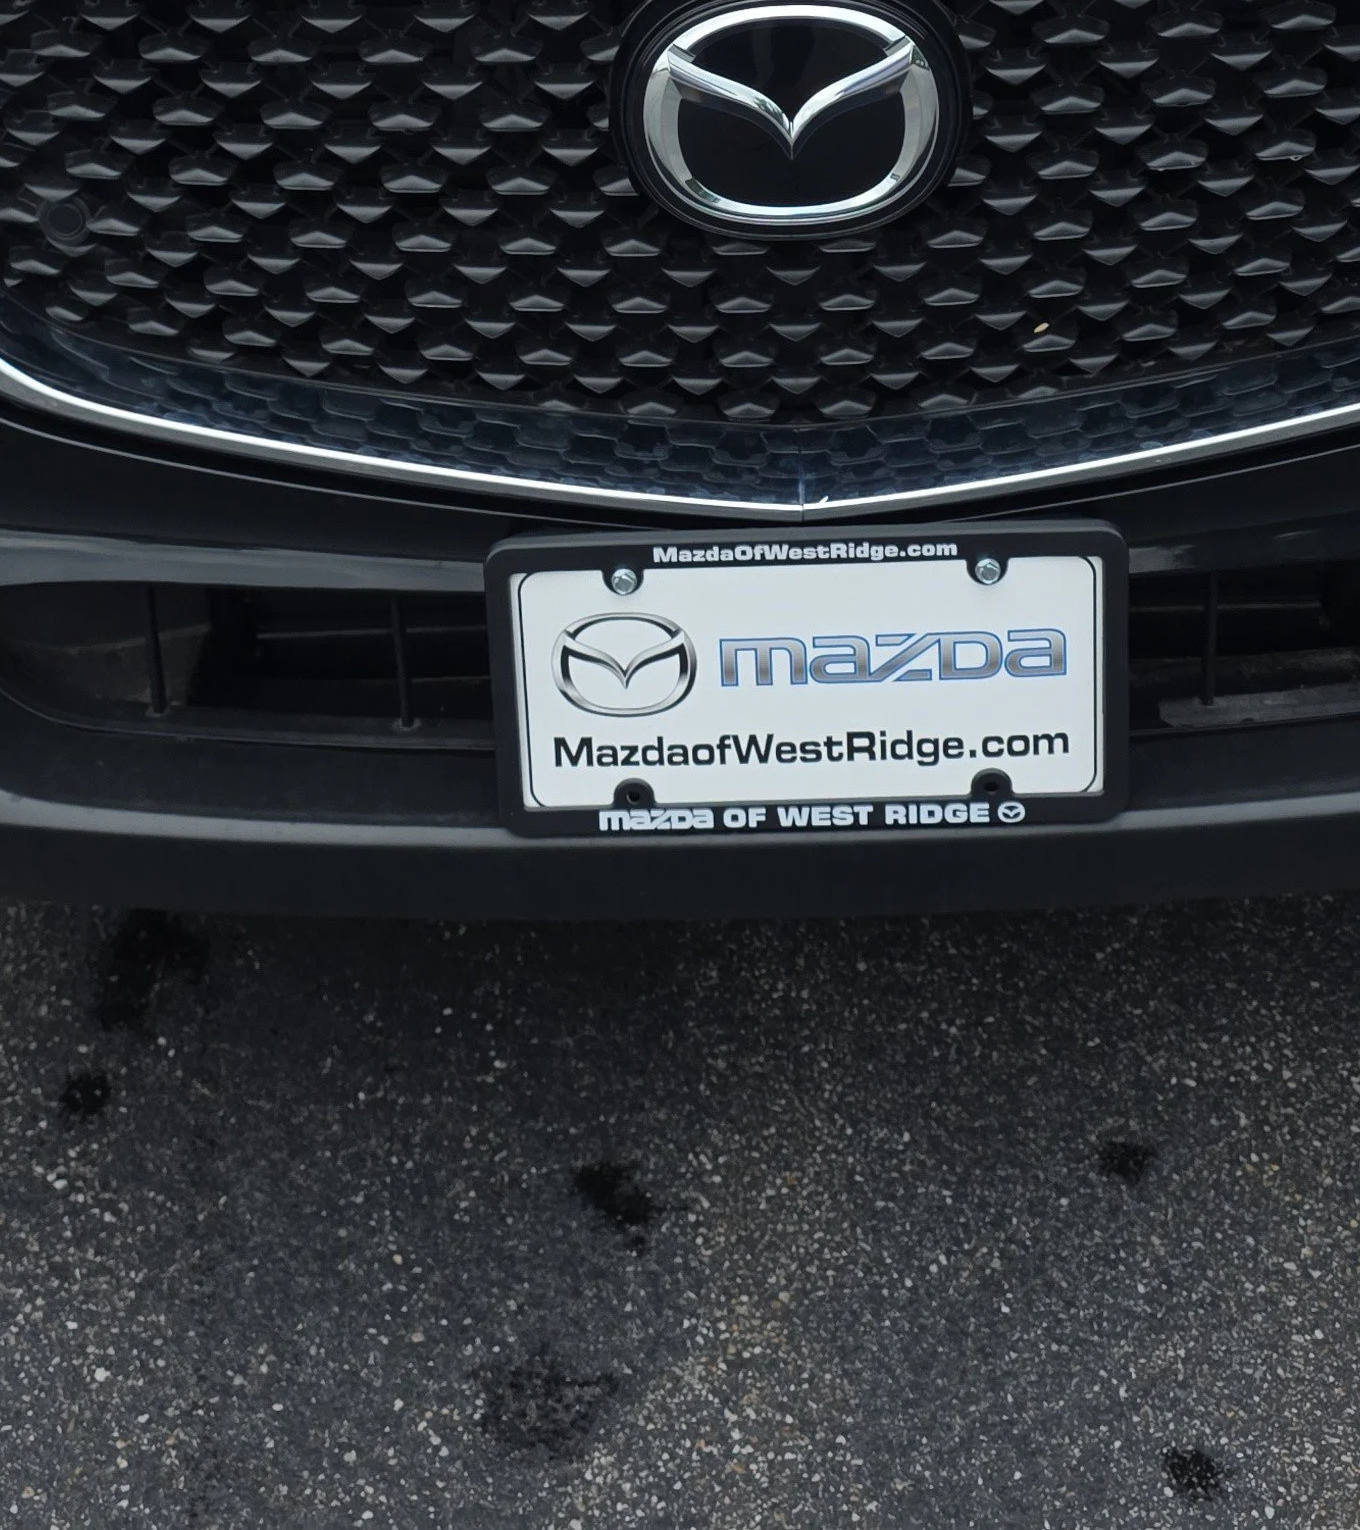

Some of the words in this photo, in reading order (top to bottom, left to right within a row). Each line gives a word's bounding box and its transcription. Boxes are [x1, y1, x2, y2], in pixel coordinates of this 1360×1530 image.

[652, 540, 958, 564] MazdaOfWestRidge.com
[552, 729, 1070, 769] MazdaofWestRidge.com
[722, 806, 767, 830] OF
[776, 804, 874, 828] WEST
[884, 801, 990, 827] RIDGE
